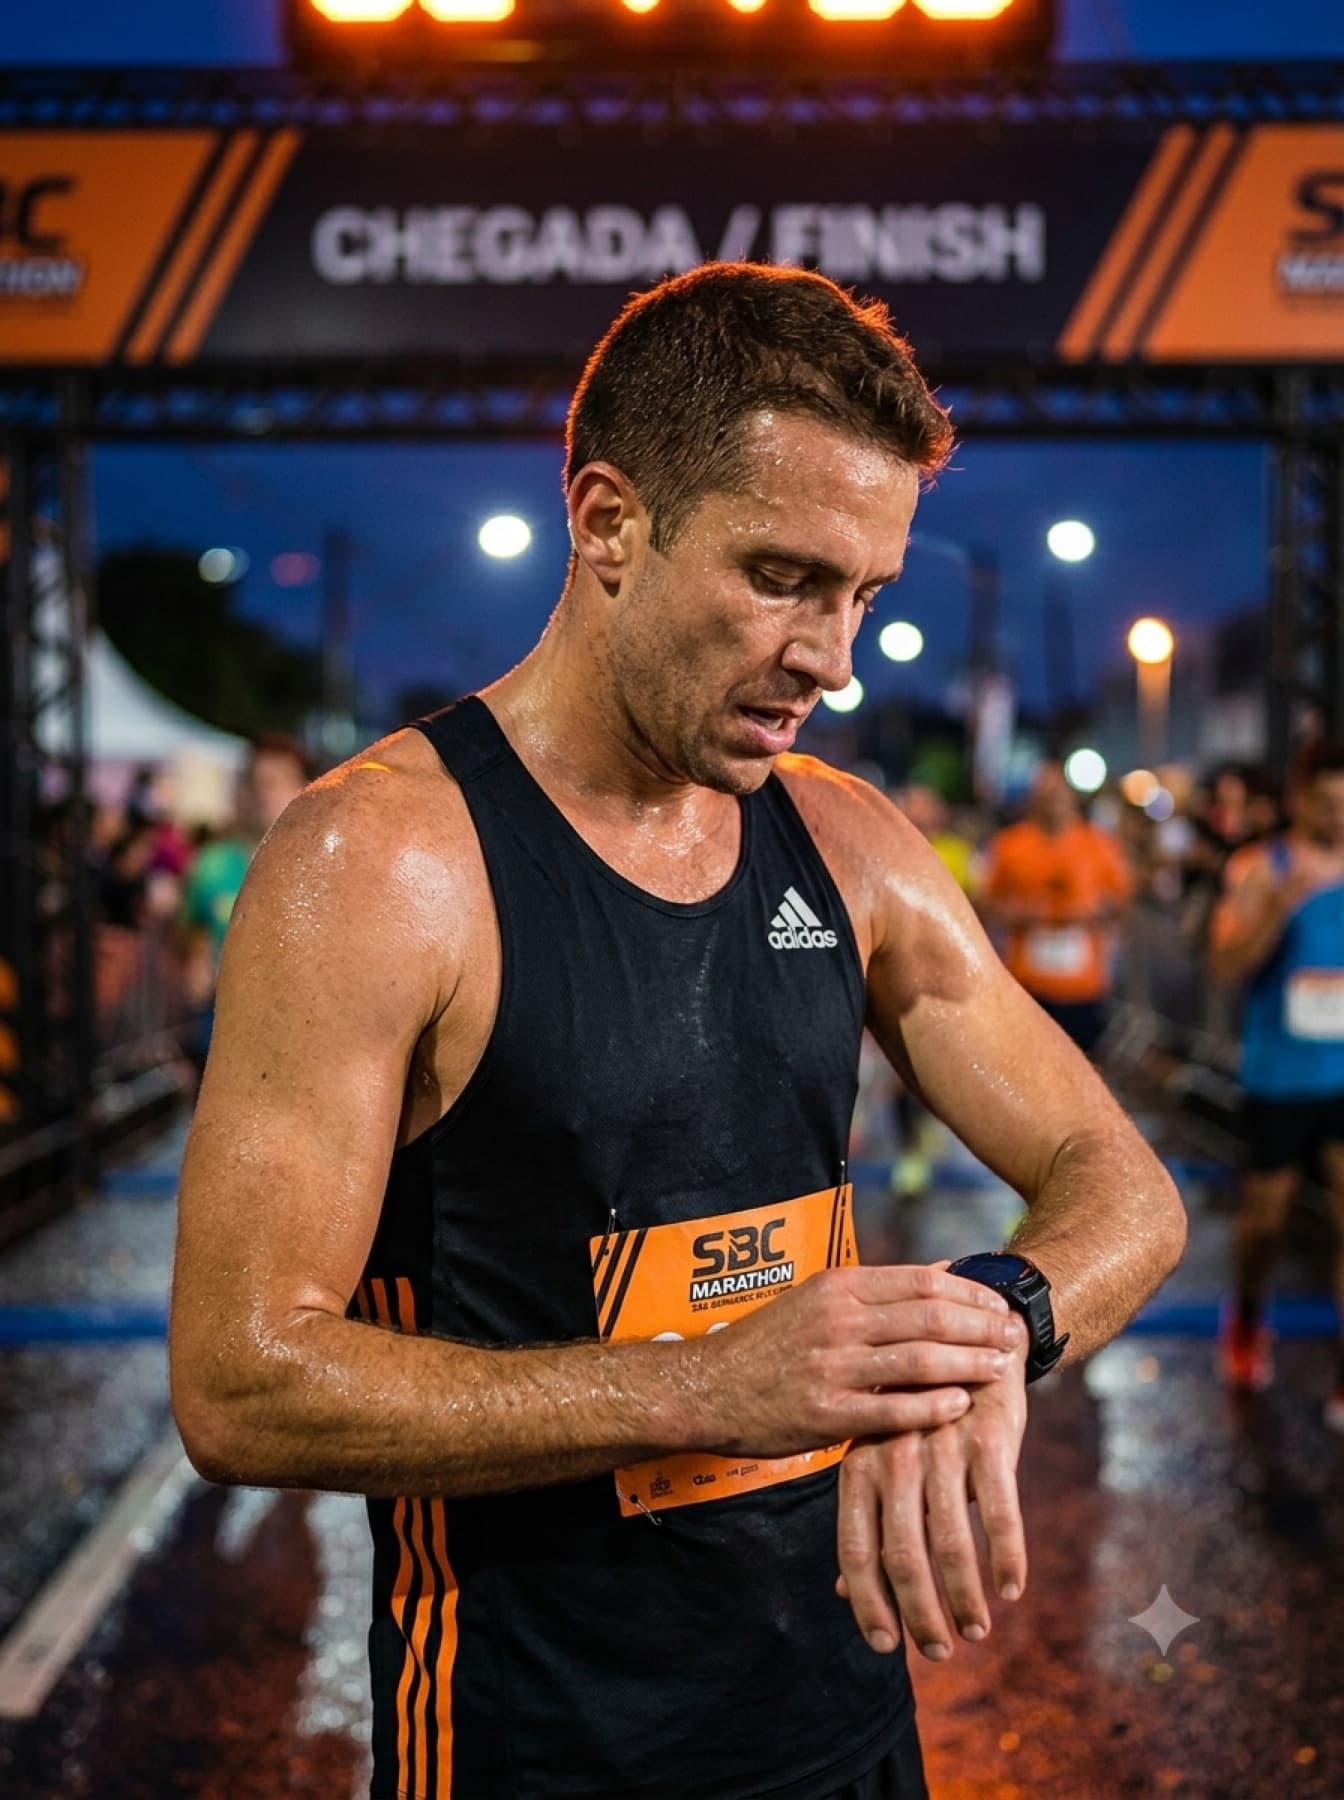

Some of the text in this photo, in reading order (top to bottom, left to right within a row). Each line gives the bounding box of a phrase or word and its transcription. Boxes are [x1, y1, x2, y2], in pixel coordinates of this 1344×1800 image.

[313, 205, 702, 284] CHEGADA
[772, 203, 1045, 283] FINISH
[768, 926, 838, 949] adidas
[692, 1218, 786, 1278] SBC
[692, 1263, 793, 1300] MARATHON
